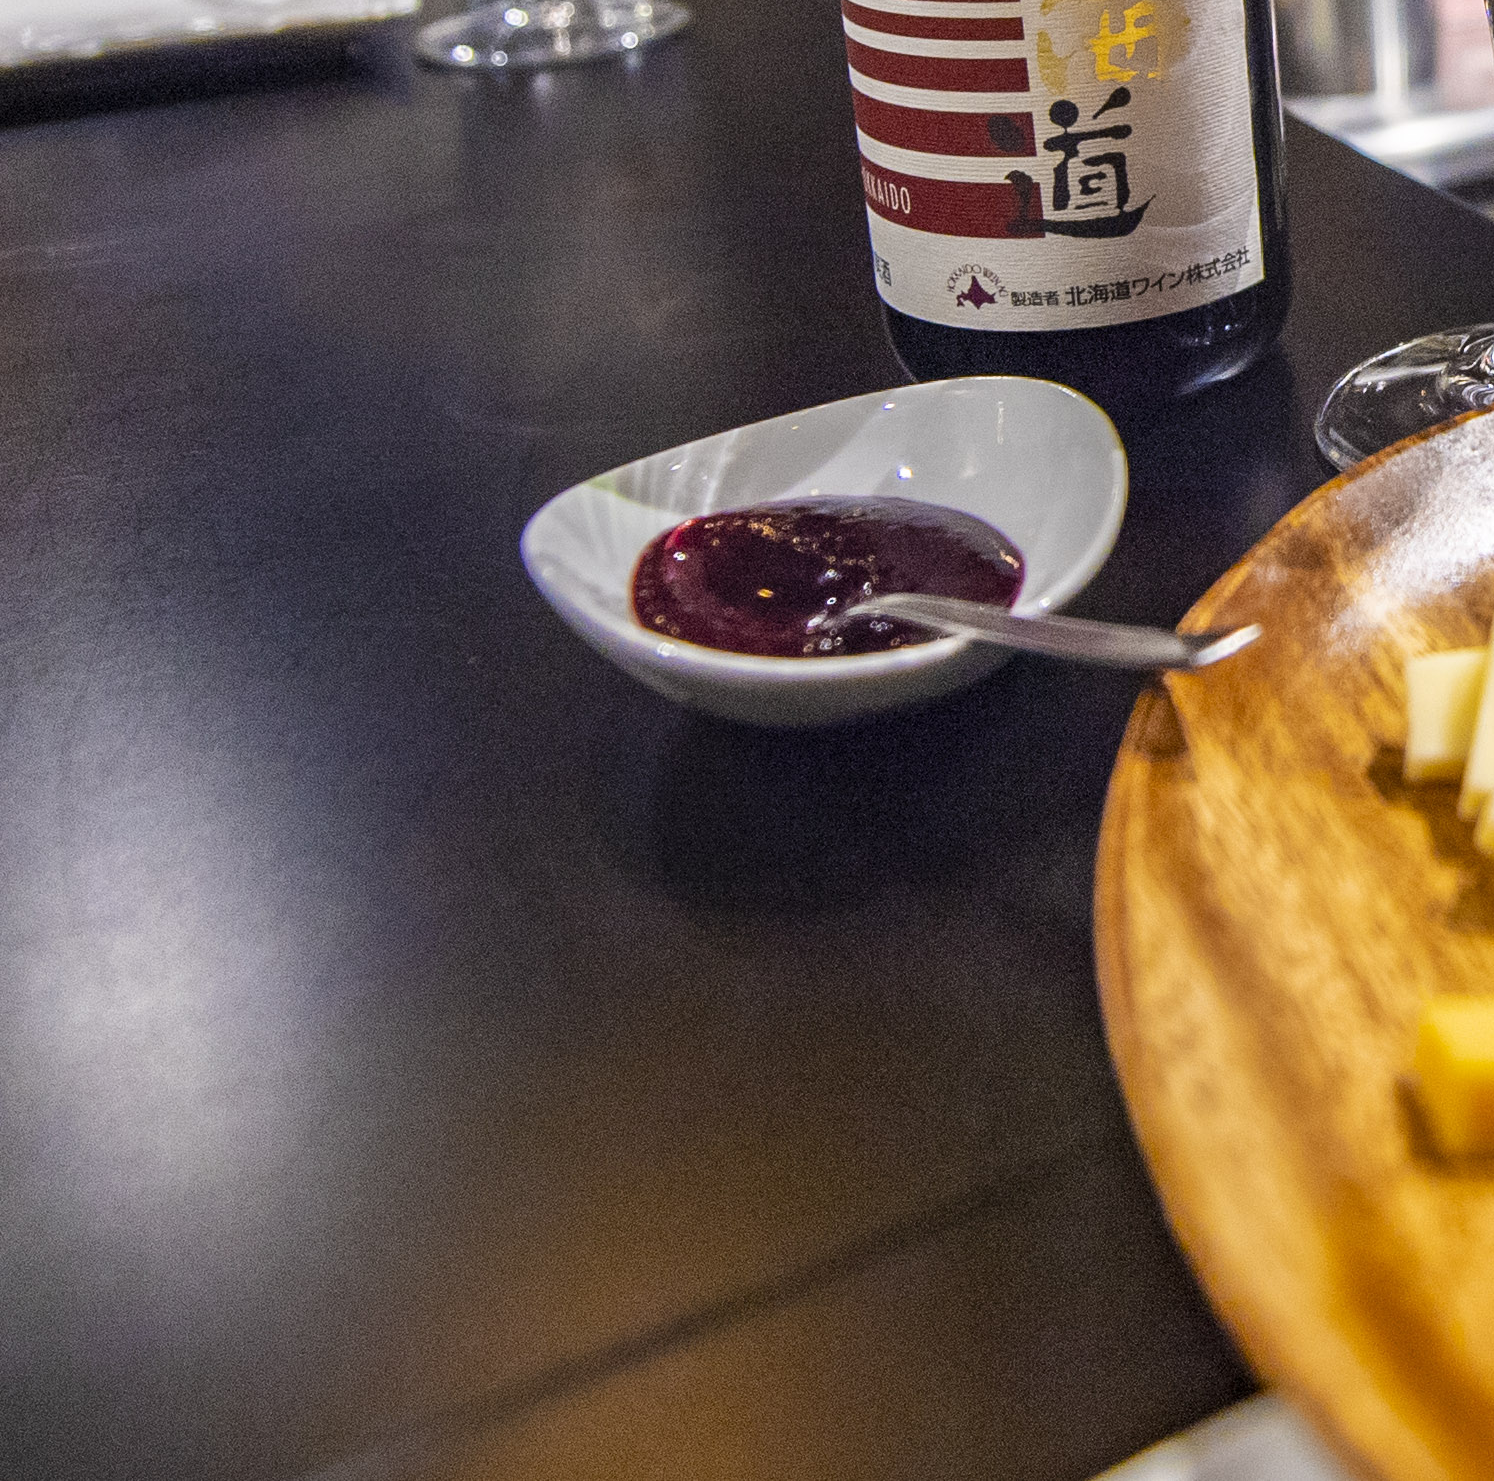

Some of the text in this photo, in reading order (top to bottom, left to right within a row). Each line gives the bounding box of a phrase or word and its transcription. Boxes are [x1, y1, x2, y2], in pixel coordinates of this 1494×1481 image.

[861, 165, 912, 214] KKAIDO
[1010, 245, 1251, 308] 製造者 北海道ワイン株式会社
